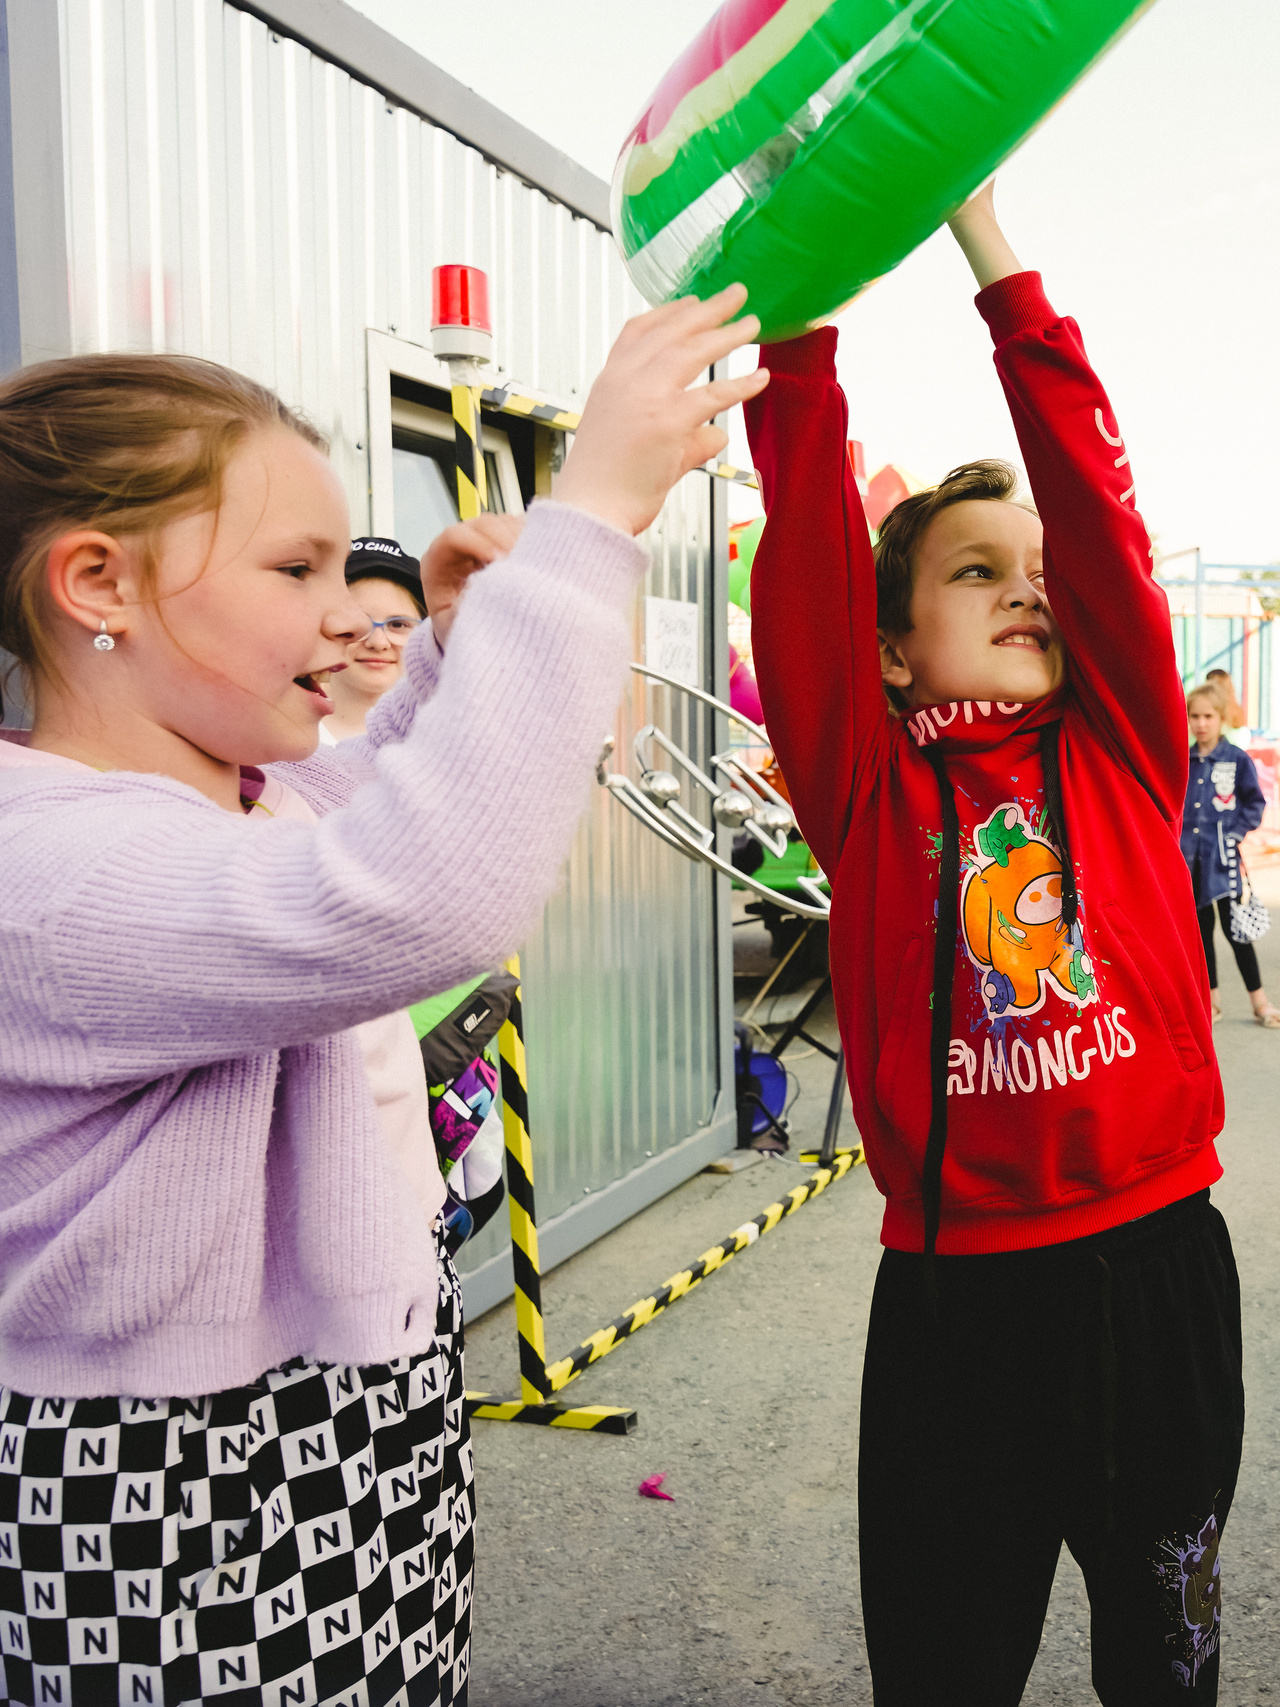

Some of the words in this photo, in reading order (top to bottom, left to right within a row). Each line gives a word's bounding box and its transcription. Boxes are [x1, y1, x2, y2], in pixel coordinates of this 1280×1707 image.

[365, 542, 402, 557] CHILL
[947, 1025, 1097, 1096] AMONG
[1093, 1006, 1137, 1065] US
[422, 1367, 437, 1399] N
[376, 1389, 402, 1419] N
[1, 1434, 18, 1464] N
[79, 1437, 106, 1467] N
[220, 1433, 246, 1464] N
[298, 1433, 326, 1466] N
[418, 1444, 439, 1473] N
[357, 1453, 372, 1489] N
[31, 1487, 52, 1516] N
[125, 1482, 151, 1513] N
[391, 1471, 416, 1503] N
[271, 1498, 285, 1534] N
[455, 1502, 467, 1534] N
[77, 1534, 102, 1562] N
[313, 1521, 340, 1555] N
[369, 1537, 382, 1574] N
[403, 1552, 426, 1586] N
[34, 1581, 55, 1610] N
[128, 1579, 150, 1608] N
[217, 1566, 246, 1596] N
[439, 1565, 451, 1600] N
[271, 1588, 295, 1625] N
[9, 1620, 23, 1650] N
[84, 1627, 107, 1655] N
[324, 1608, 350, 1643] N
[375, 1620, 391, 1657] N
[413, 1630, 433, 1665] N
[218, 1655, 246, 1685] N
[459, 1650, 467, 1682] N
[41, 1674, 62, 1703] N
[132, 1674, 153, 1703] N
